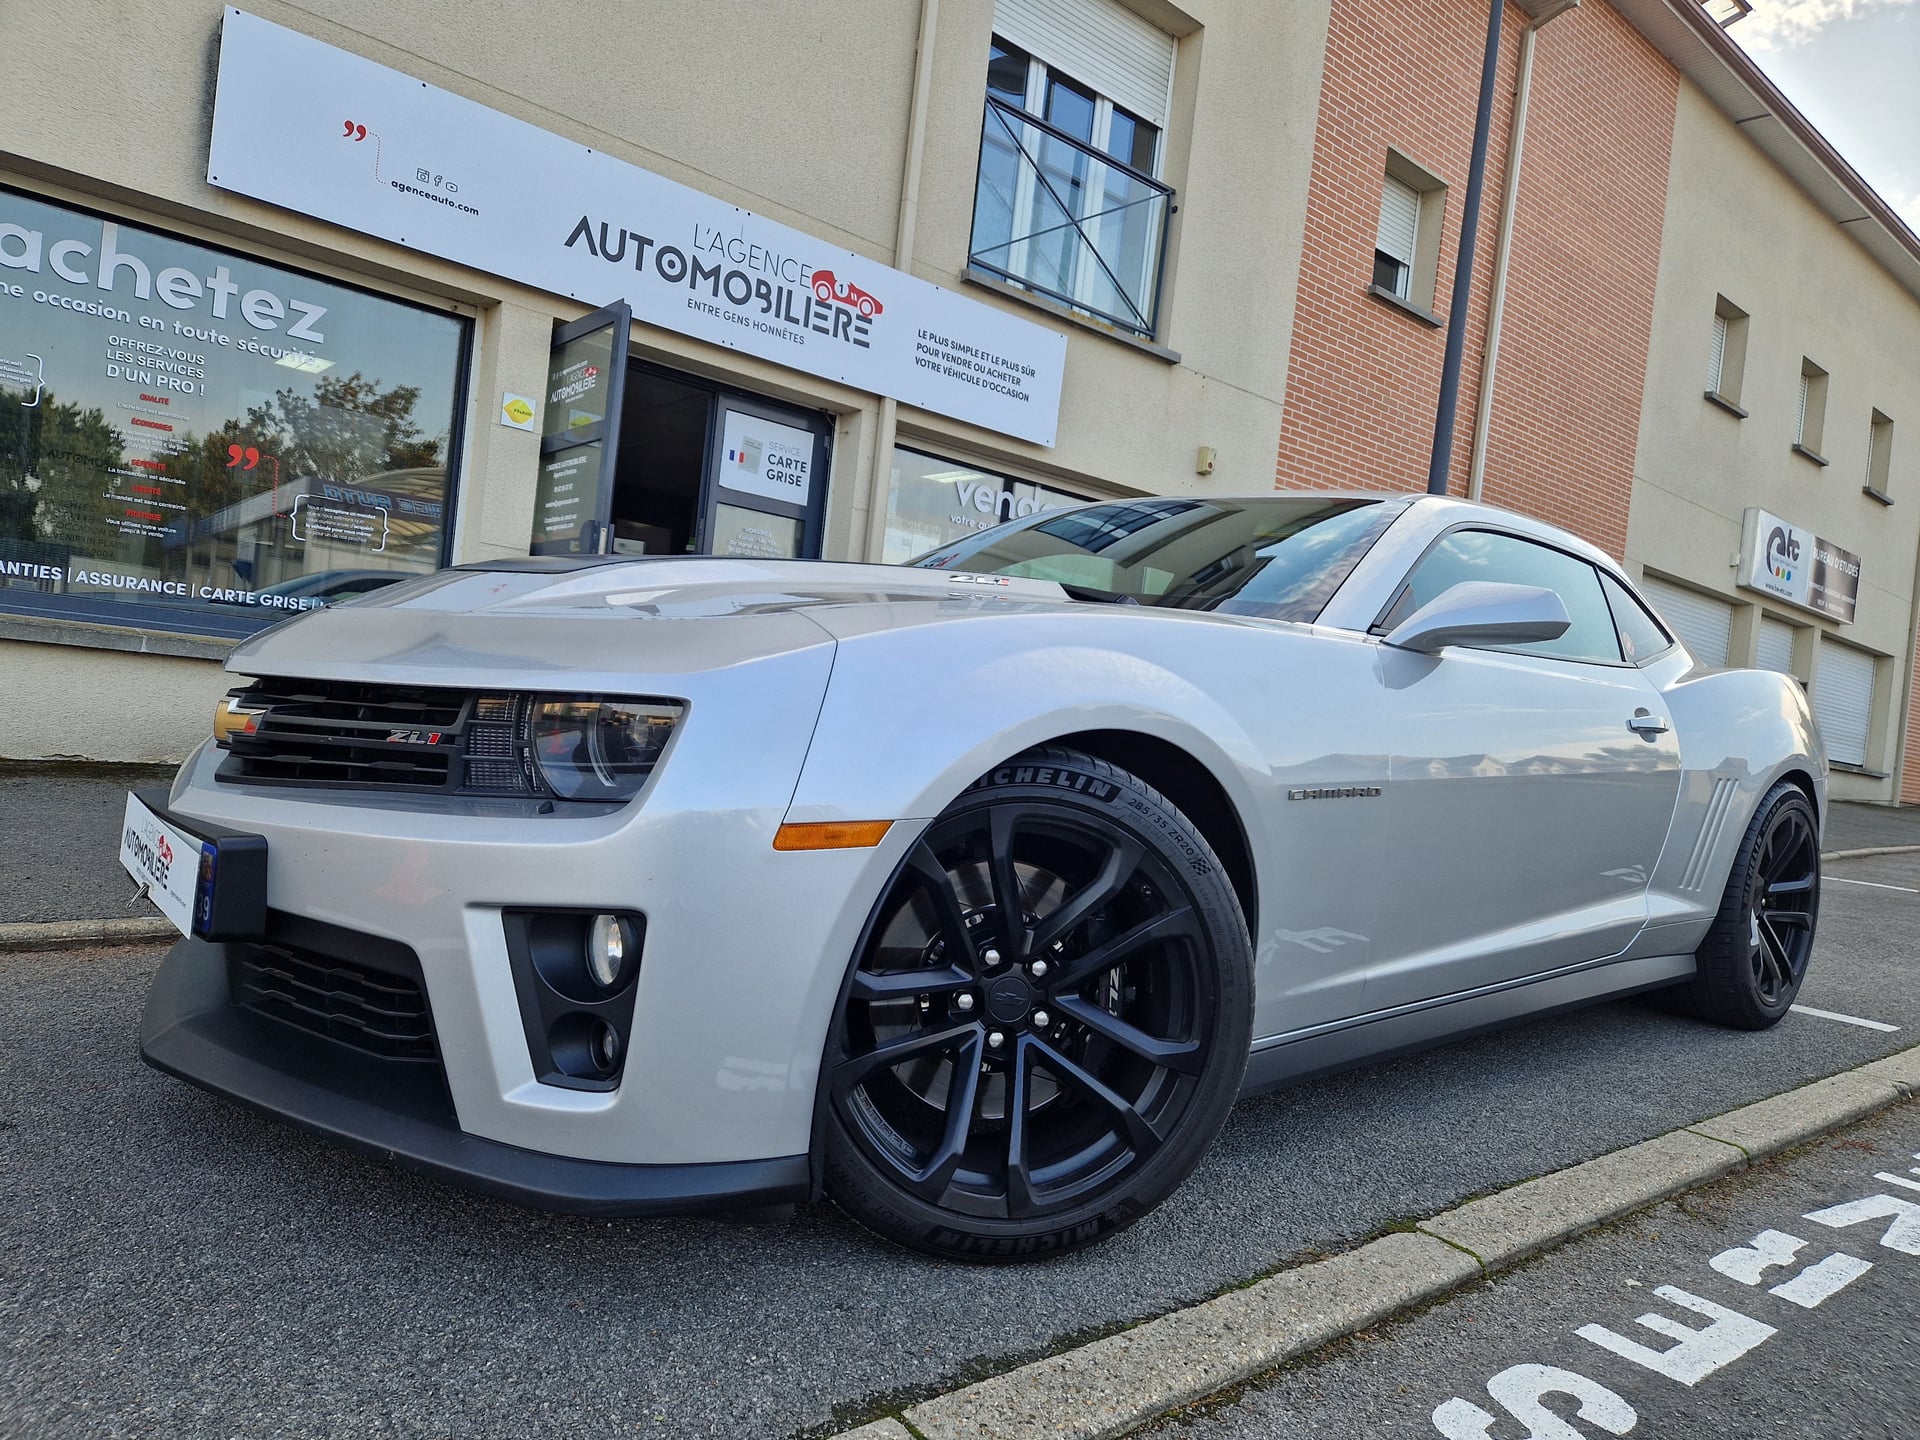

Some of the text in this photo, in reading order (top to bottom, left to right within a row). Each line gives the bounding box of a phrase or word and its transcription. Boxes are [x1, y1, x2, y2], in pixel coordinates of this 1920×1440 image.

[391, 180, 479, 215] agenceauto.com
[693, 223, 813, 288] L'AGENCE
[0, 221, 328, 343] achetez
[33, 290, 130, 323] occasion
[139, 315, 165, 331] en
[173, 320, 230, 346] toute
[237, 337, 316, 366] sécurité
[687, 298, 805, 345] ENTRE GENS HONNÊTES
[107, 349, 204, 379] LES SERVICES
[108, 335, 205, 365] OFFREZ-VOUS
[916, 342, 1021, 386] POUR VENDRE OU ACHETER
[918, 328, 1036, 378] LE PLUS SIMPLE ET LE PLUS SÛR
[106, 364, 205, 396] D'UN PRO !
[915, 356, 1029, 402] VOTRE VÉHICULE D'OCCASION
[140, 393, 170, 405] QUALITÉ
[768, 441, 801, 456] SERVICE
[768, 454, 808, 474] CARTE
[766, 468, 802, 487] GRISE
[956, 480, 1056, 520] vend
[950, 514, 976, 528] votre
[1813, 547, 1834, 568] BUREAU
[75, 570, 187, 596] ASSURANCE
[200, 586, 256, 605] CARTE
[260, 594, 308, 611] GRISE
[386, 729, 441, 746] ZL1
[970, 767, 1112, 798] ICHELIN
[1288, 786, 1382, 801] CAMARO
[1432, 1149, 1920, 1440] SERV
